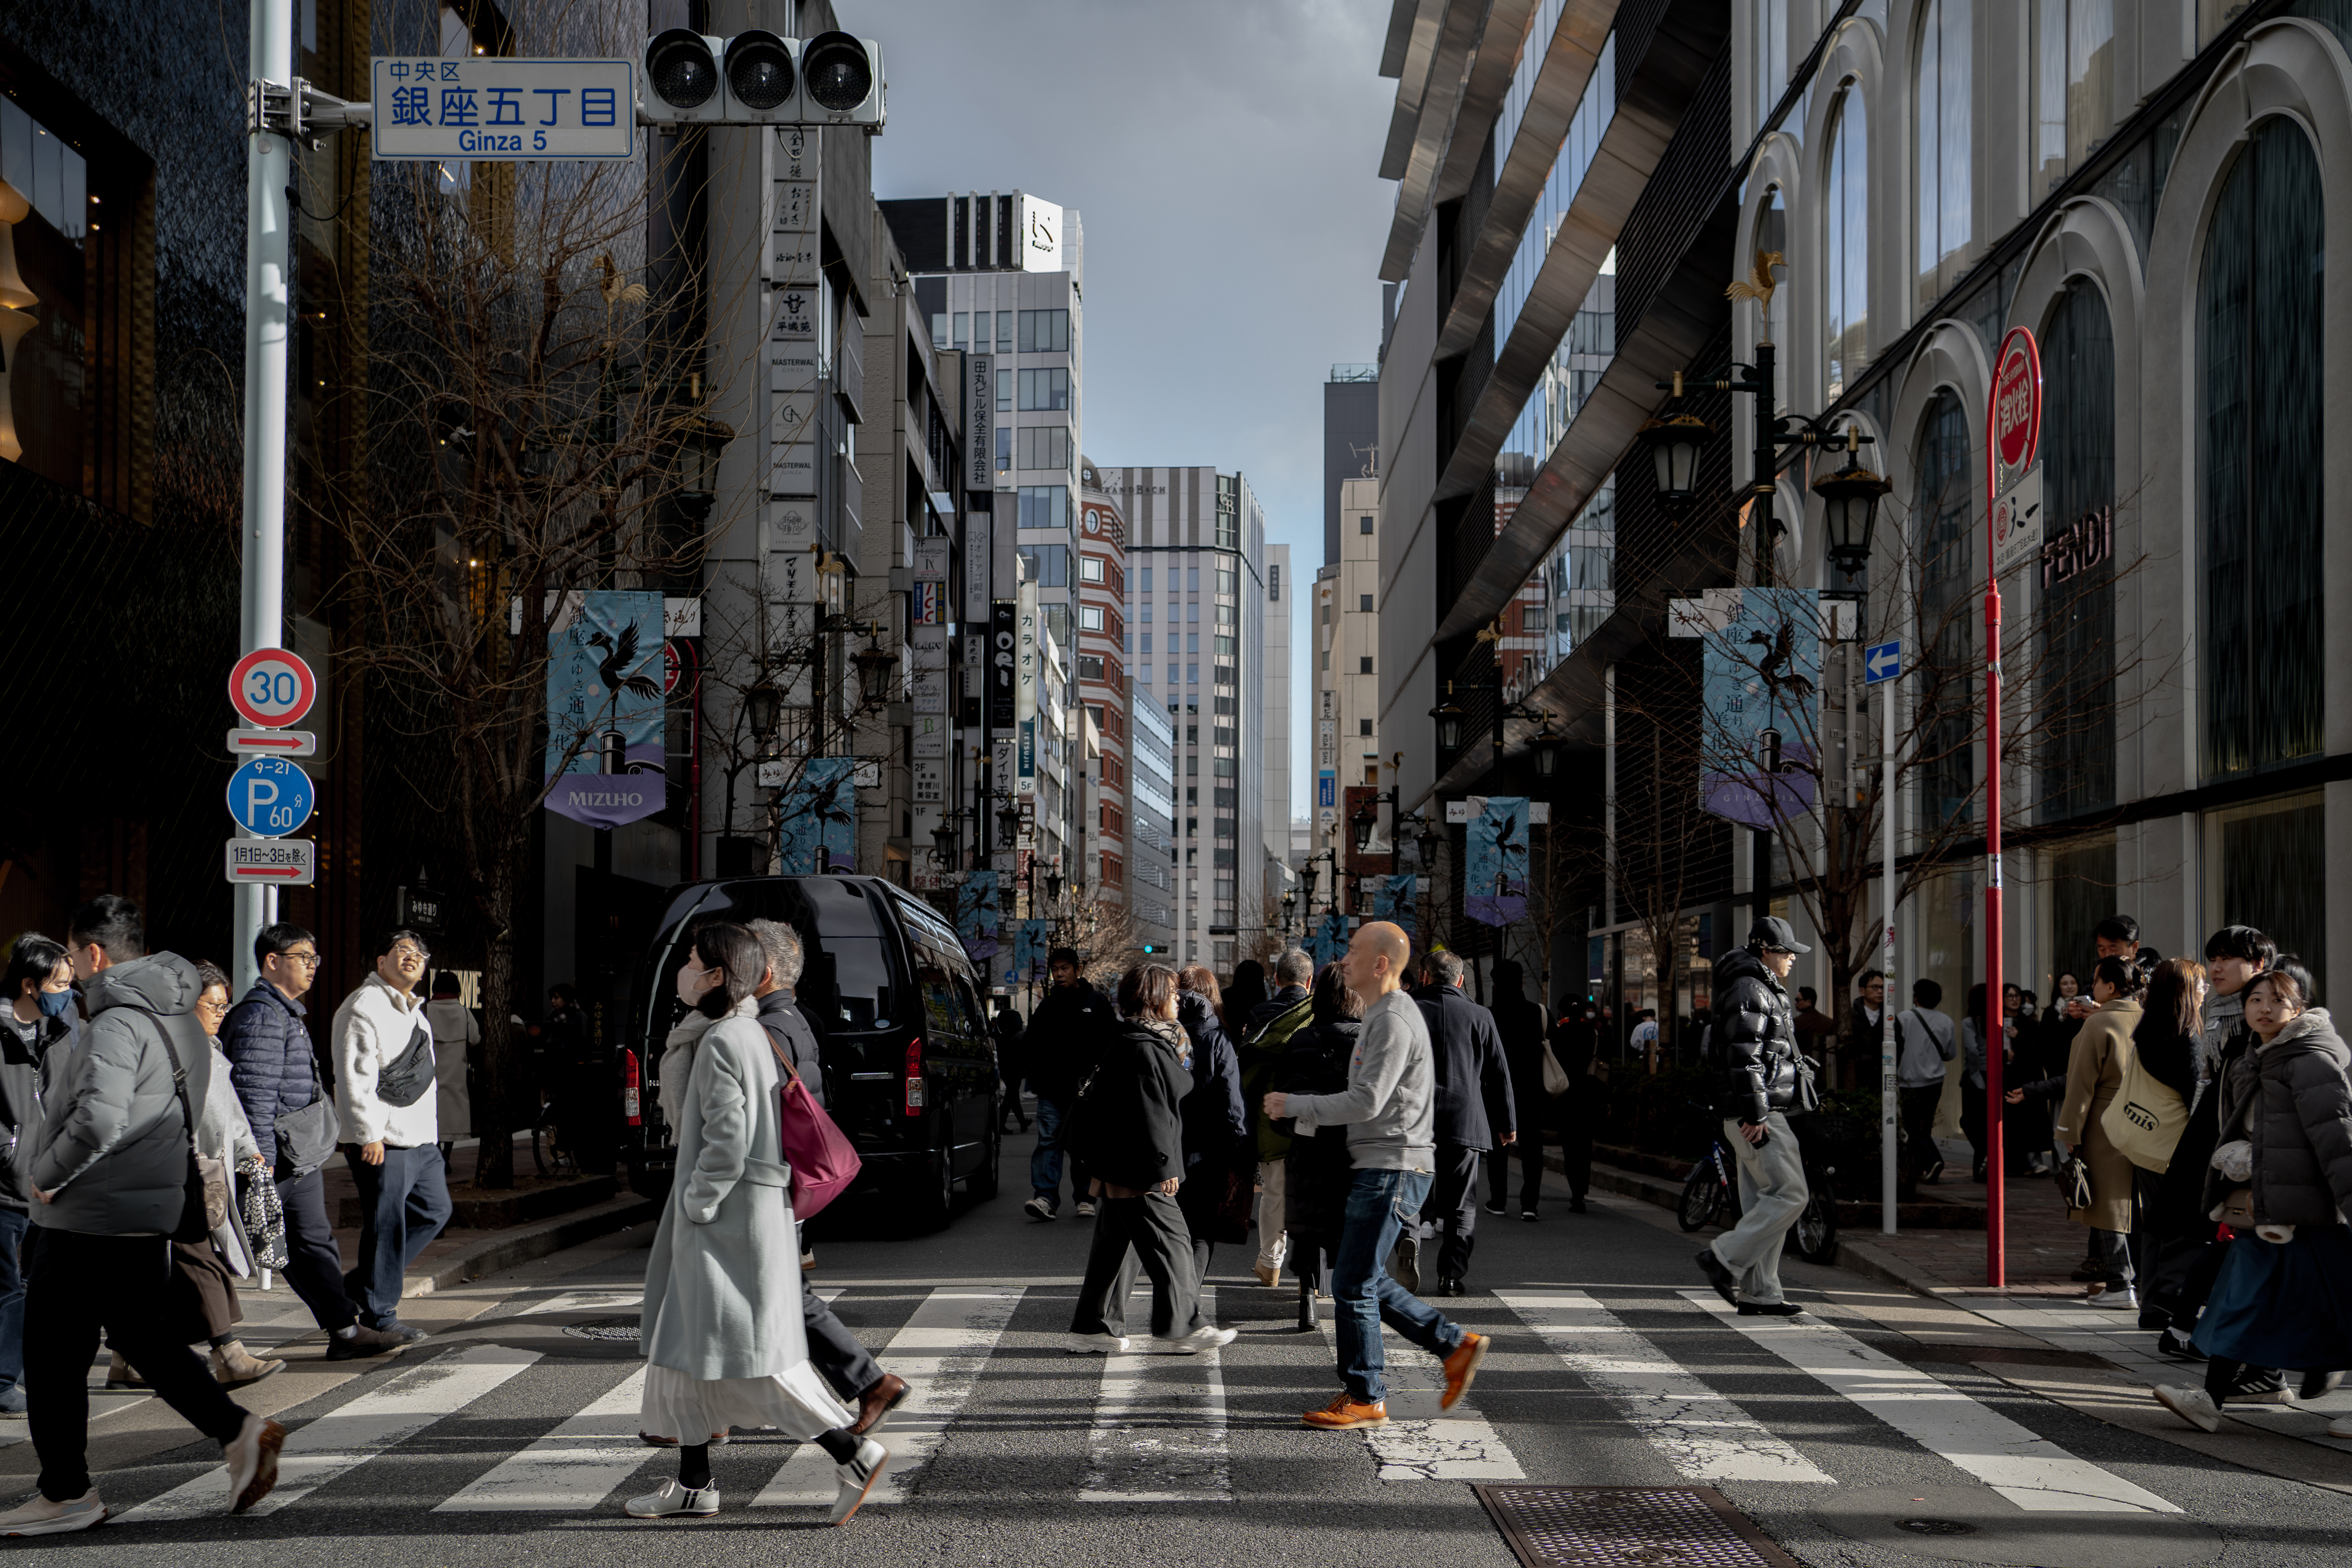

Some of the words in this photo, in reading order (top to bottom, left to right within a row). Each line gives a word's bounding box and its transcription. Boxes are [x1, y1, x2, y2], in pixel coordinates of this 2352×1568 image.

[390, 62, 460, 82] 中央区
[391, 86, 616, 127] 銀座五丁目
[459, 130, 521, 152] Ginza
[533, 130, 547, 151] 5
[777, 321, 811, 332] 平城苑
[2001, 377, 2029, 440] 消火栓
[974, 361, 987, 485] 田丸ビル保全有限会社
[915, 539, 926, 548] 7F
[2040, 505, 2111, 590] FENDI
[924, 583, 934, 622] ICC
[1022, 615, 1033, 685] カラオケ
[568, 605, 589, 730] 銀座みゆき通り
[1725, 604, 1747, 729] 銀座ゆき通り
[250, 671, 295, 705] 30
[915, 675, 926, 683] 5F
[255, 762, 289, 775] 9-21
[915, 763, 926, 772] 2F
[1021, 781, 1032, 790] 5F
[247, 778, 279, 827] P
[294, 794, 302, 808] 分
[568, 791, 643, 807] MIZUHO
[1022, 805, 1031, 814] 和
[269, 806, 292, 828] 60
[915, 808, 926, 816] 1F
[914, 875, 940, 888] 整体
[413, 900, 437, 916] みゆき通り
[593, 1002, 603, 1046] みゆき通り
